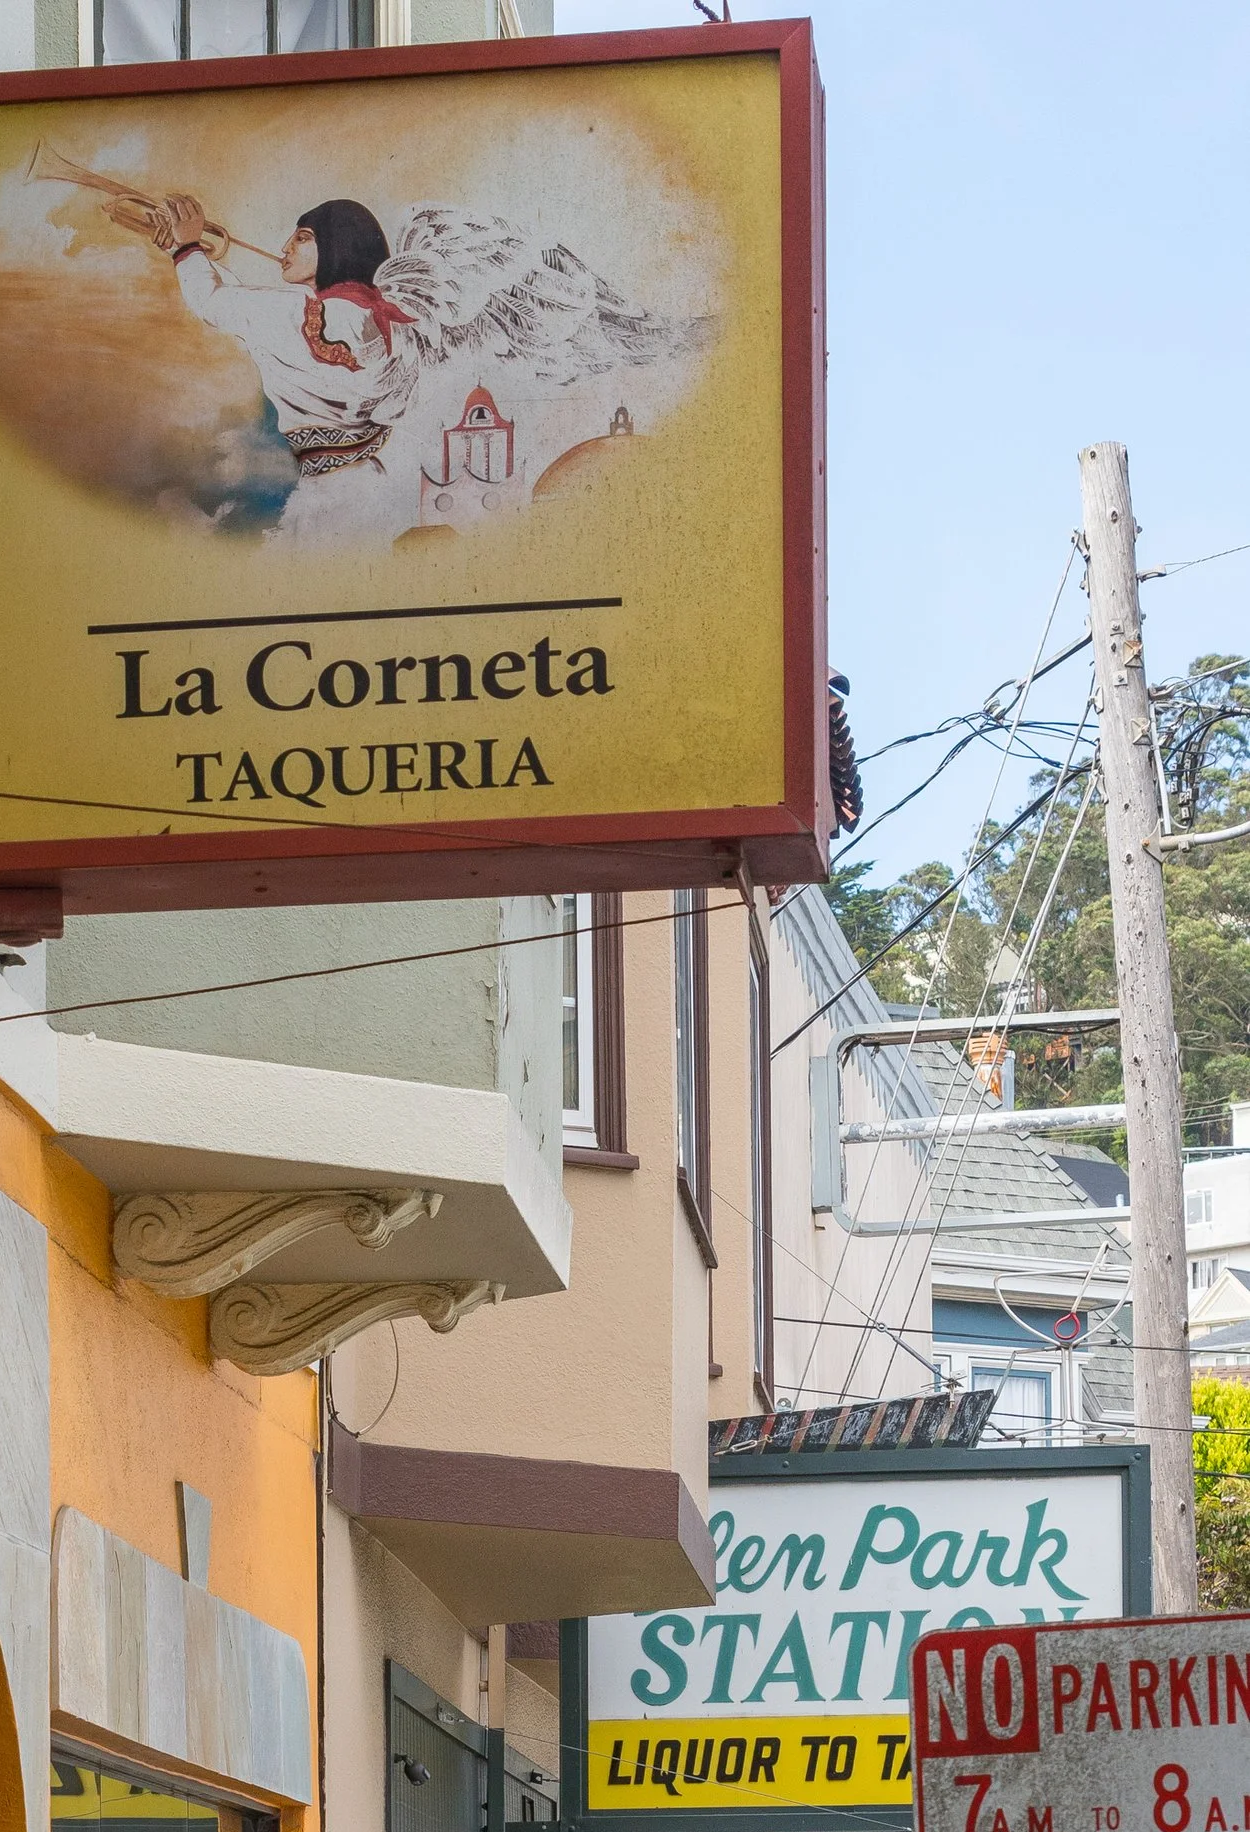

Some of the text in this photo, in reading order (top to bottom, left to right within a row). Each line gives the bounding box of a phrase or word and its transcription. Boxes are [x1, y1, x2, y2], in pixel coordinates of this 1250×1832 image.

[115, 636, 616, 719] La Corneta
[176, 736, 553, 808] TAQUERIA
[708, 1498, 1089, 1600] len Park
[631, 1606, 1083, 1706] STATI
[926, 1643, 1025, 1742] NO
[607, 1737, 780, 1796] LIQUOR
[801, 1736, 857, 1782] TO
[1091, 1806, 1121, 1832] TO
[1205, 1794, 1250, 1832] A.
